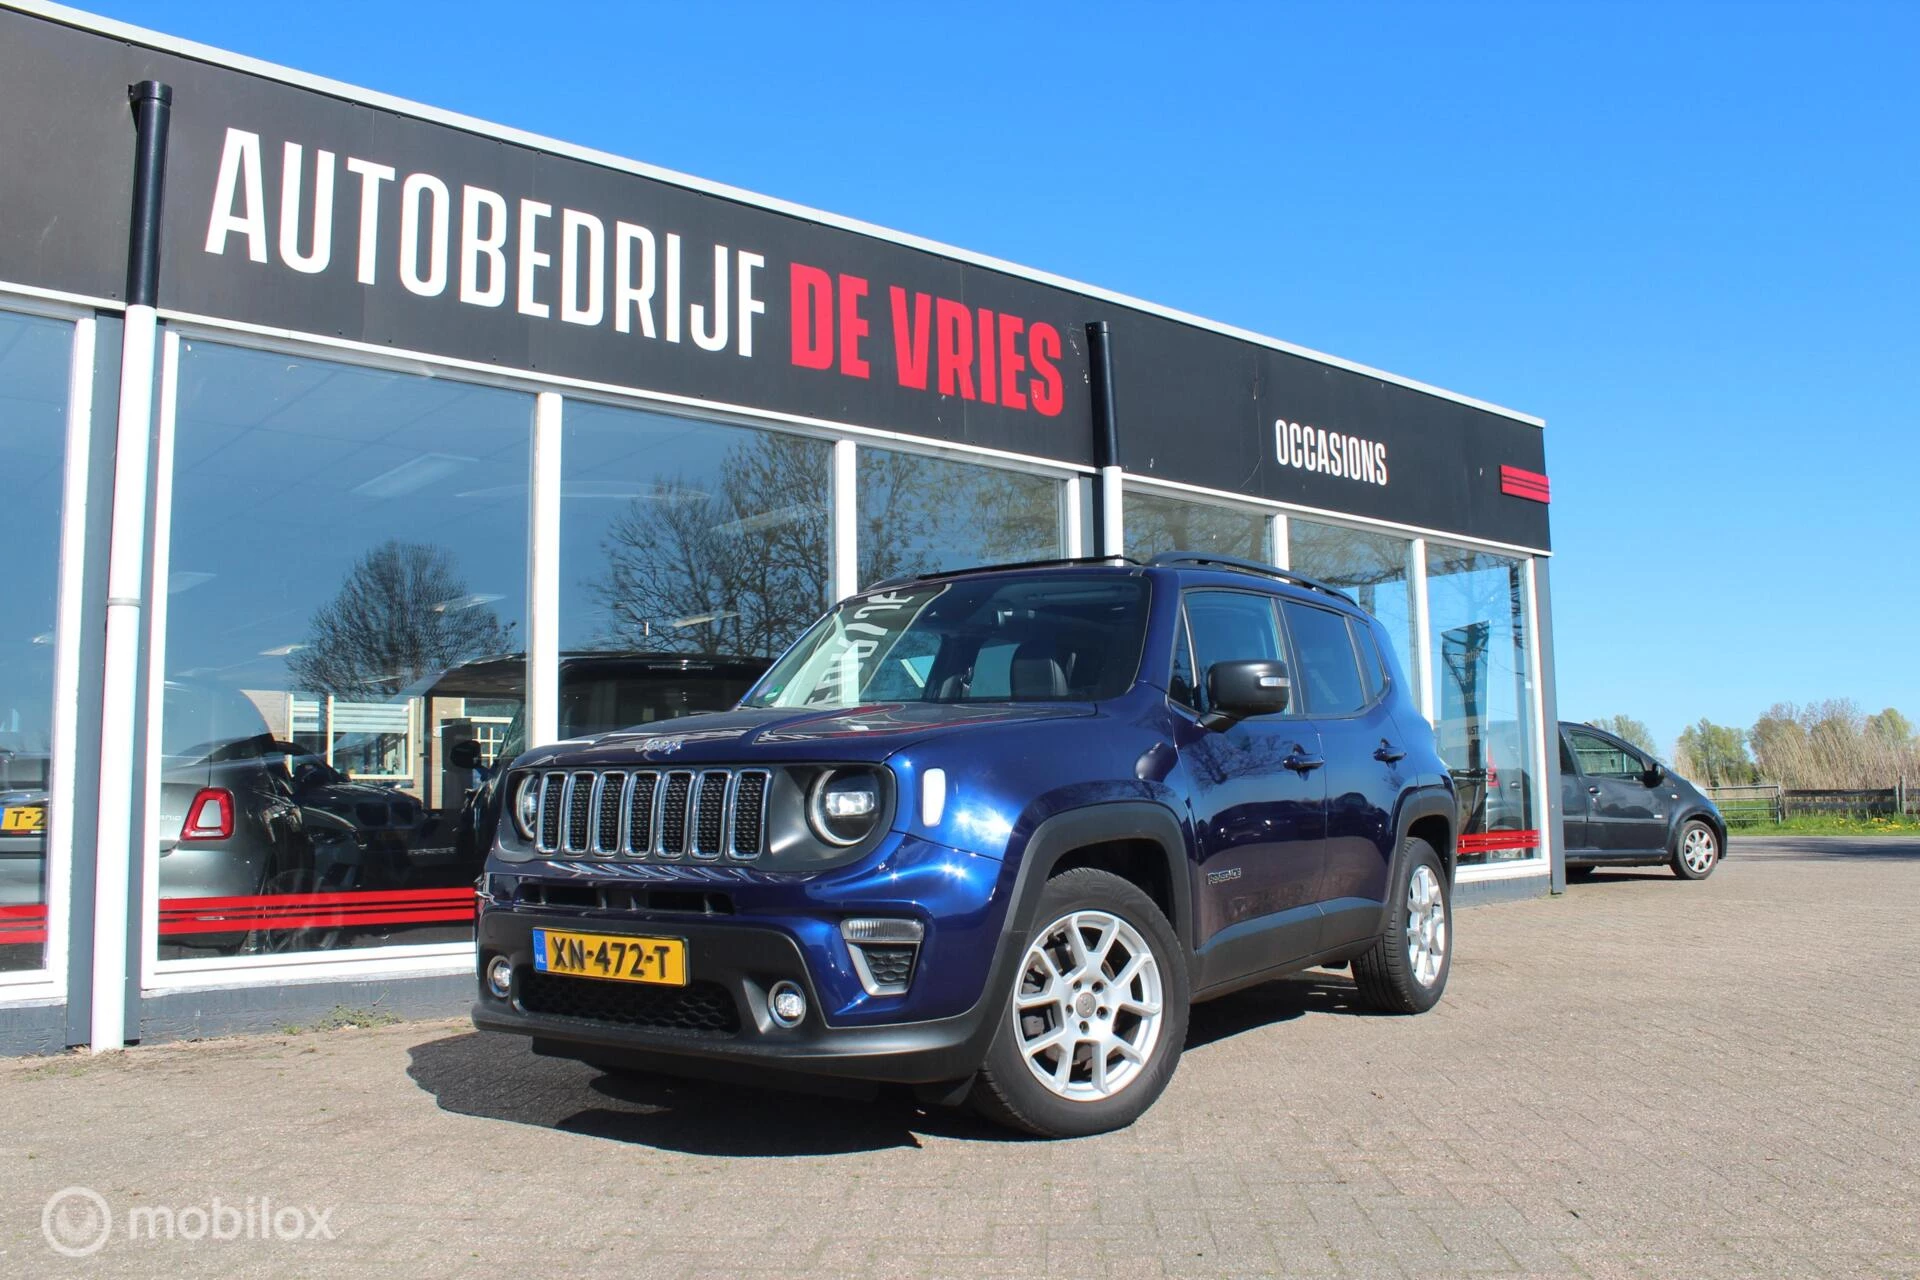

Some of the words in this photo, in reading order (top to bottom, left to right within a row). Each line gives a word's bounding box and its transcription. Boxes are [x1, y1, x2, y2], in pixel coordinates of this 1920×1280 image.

[205, 127, 765, 358] AUTOBEDRIJF
[790, 262, 870, 379] DE
[889, 285, 1064, 417] VRIES
[1275, 419, 1387, 486] OCCASIONS
[535, 953, 546, 964] NL
[551, 936, 670, 979] XN-472-T
